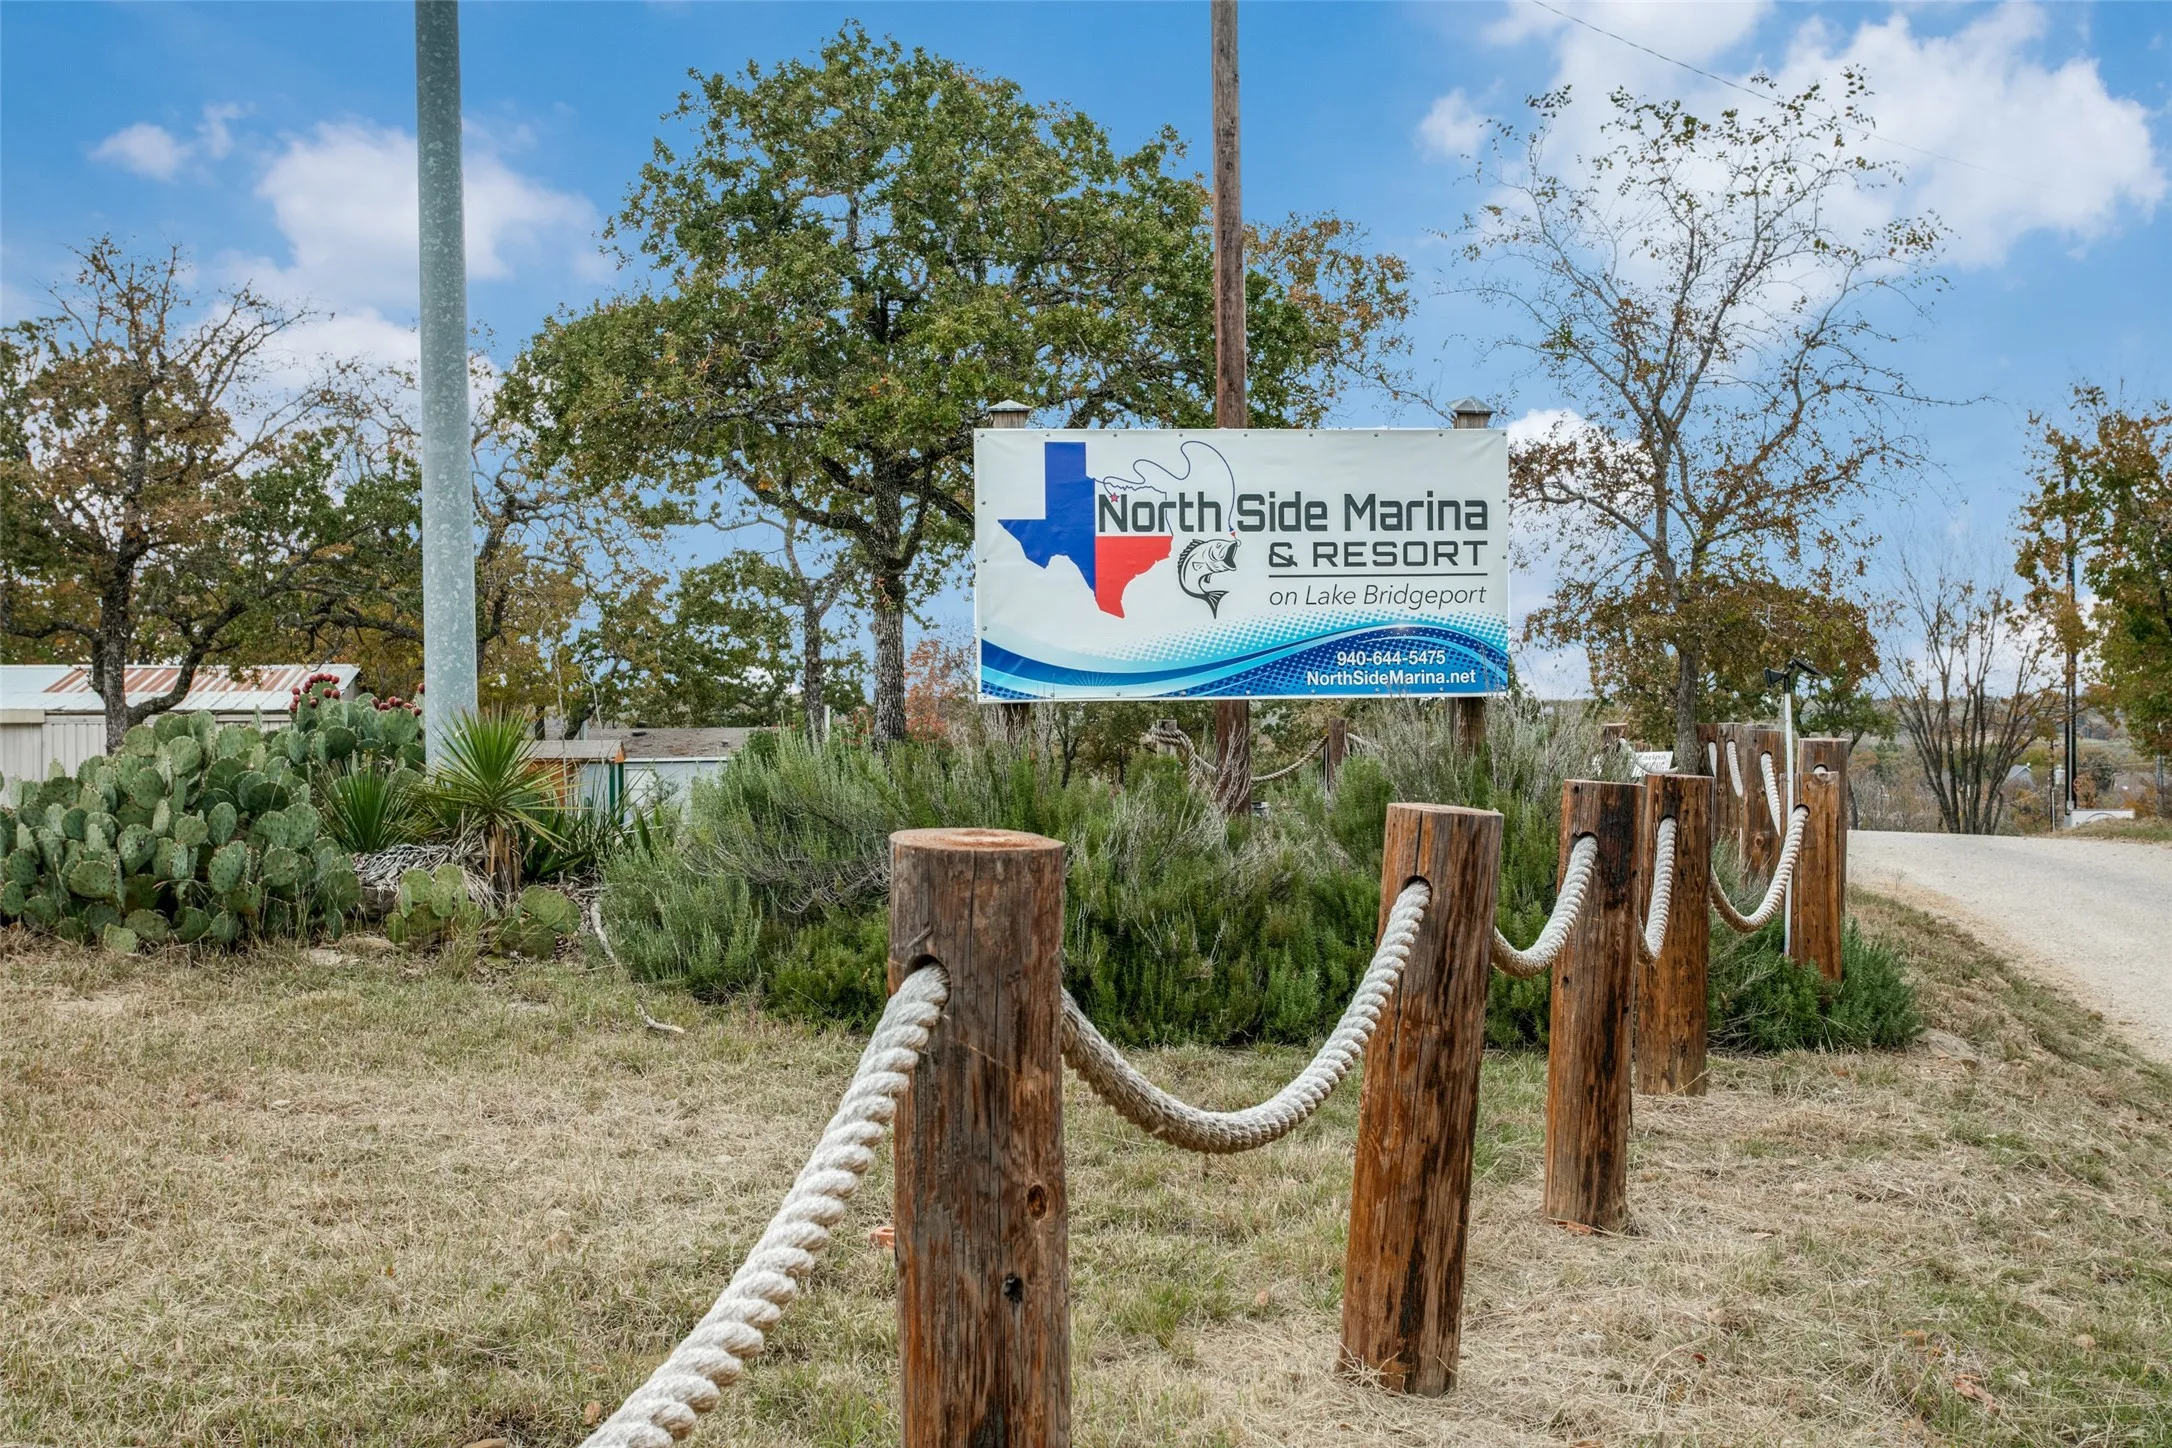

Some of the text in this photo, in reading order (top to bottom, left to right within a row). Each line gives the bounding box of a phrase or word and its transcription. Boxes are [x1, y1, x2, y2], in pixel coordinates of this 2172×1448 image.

[1099, 491, 1488, 532] North Side Marina
[1269, 541, 1488, 567] & RESORT
[1269, 583, 1487, 610] on Lake Bridgeport
[1337, 650, 1446, 666] 940-644-5475
[1307, 669, 1476, 686] NorthSideMarina.net
